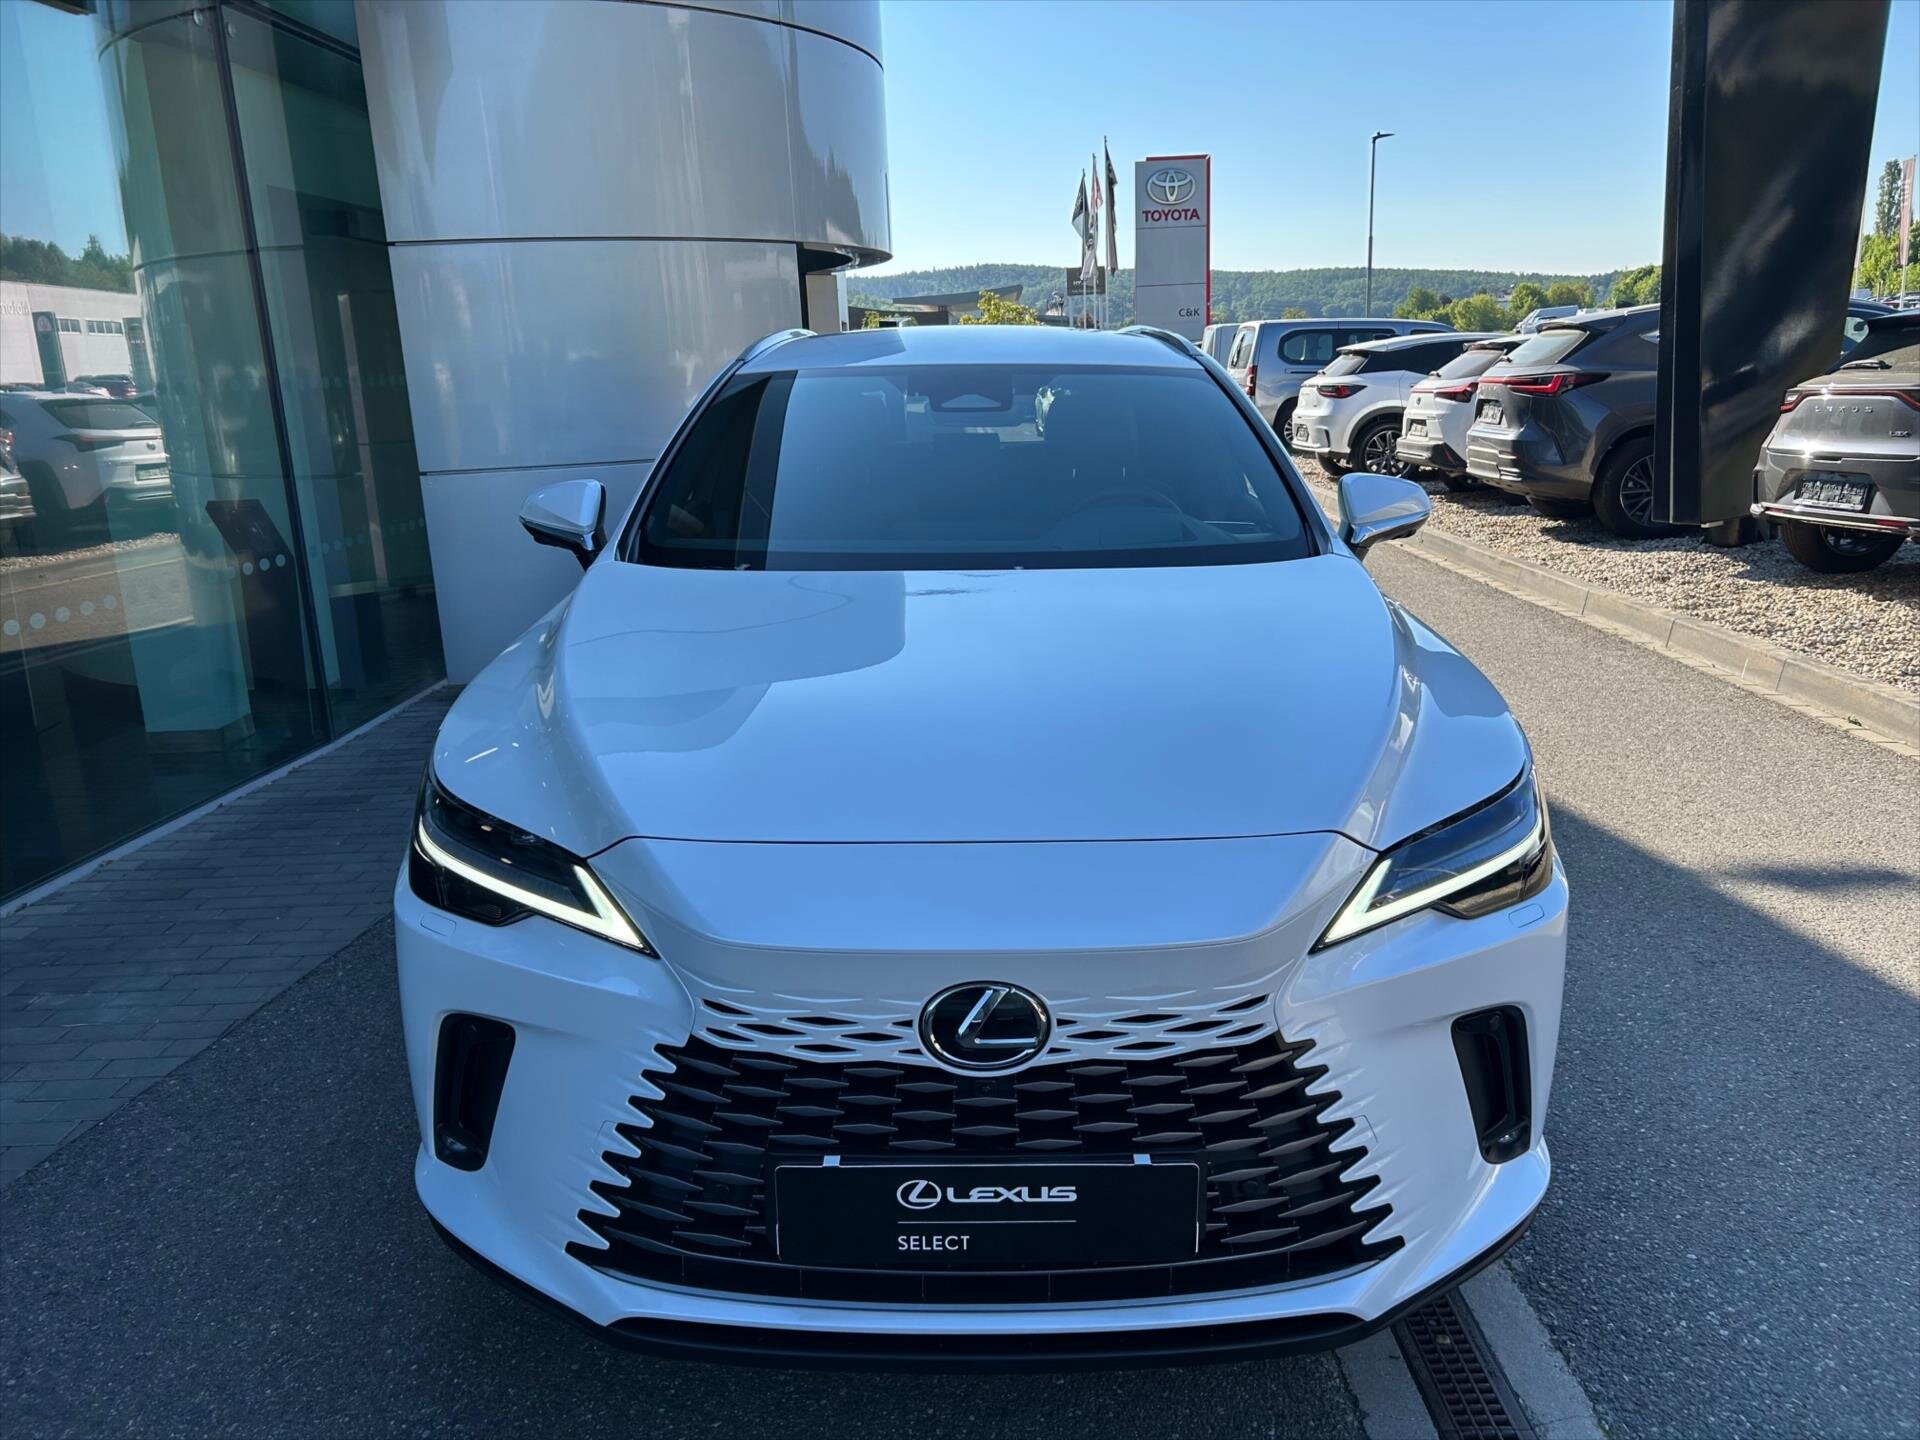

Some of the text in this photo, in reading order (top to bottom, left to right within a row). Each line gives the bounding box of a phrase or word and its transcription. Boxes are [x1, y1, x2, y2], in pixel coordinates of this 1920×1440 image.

[1142, 208, 1200, 222] TOYOTA
[1178, 307, 1200, 317] C&K
[946, 1186, 1077, 1202] LEXUS
[898, 1235, 970, 1251] SELECT
